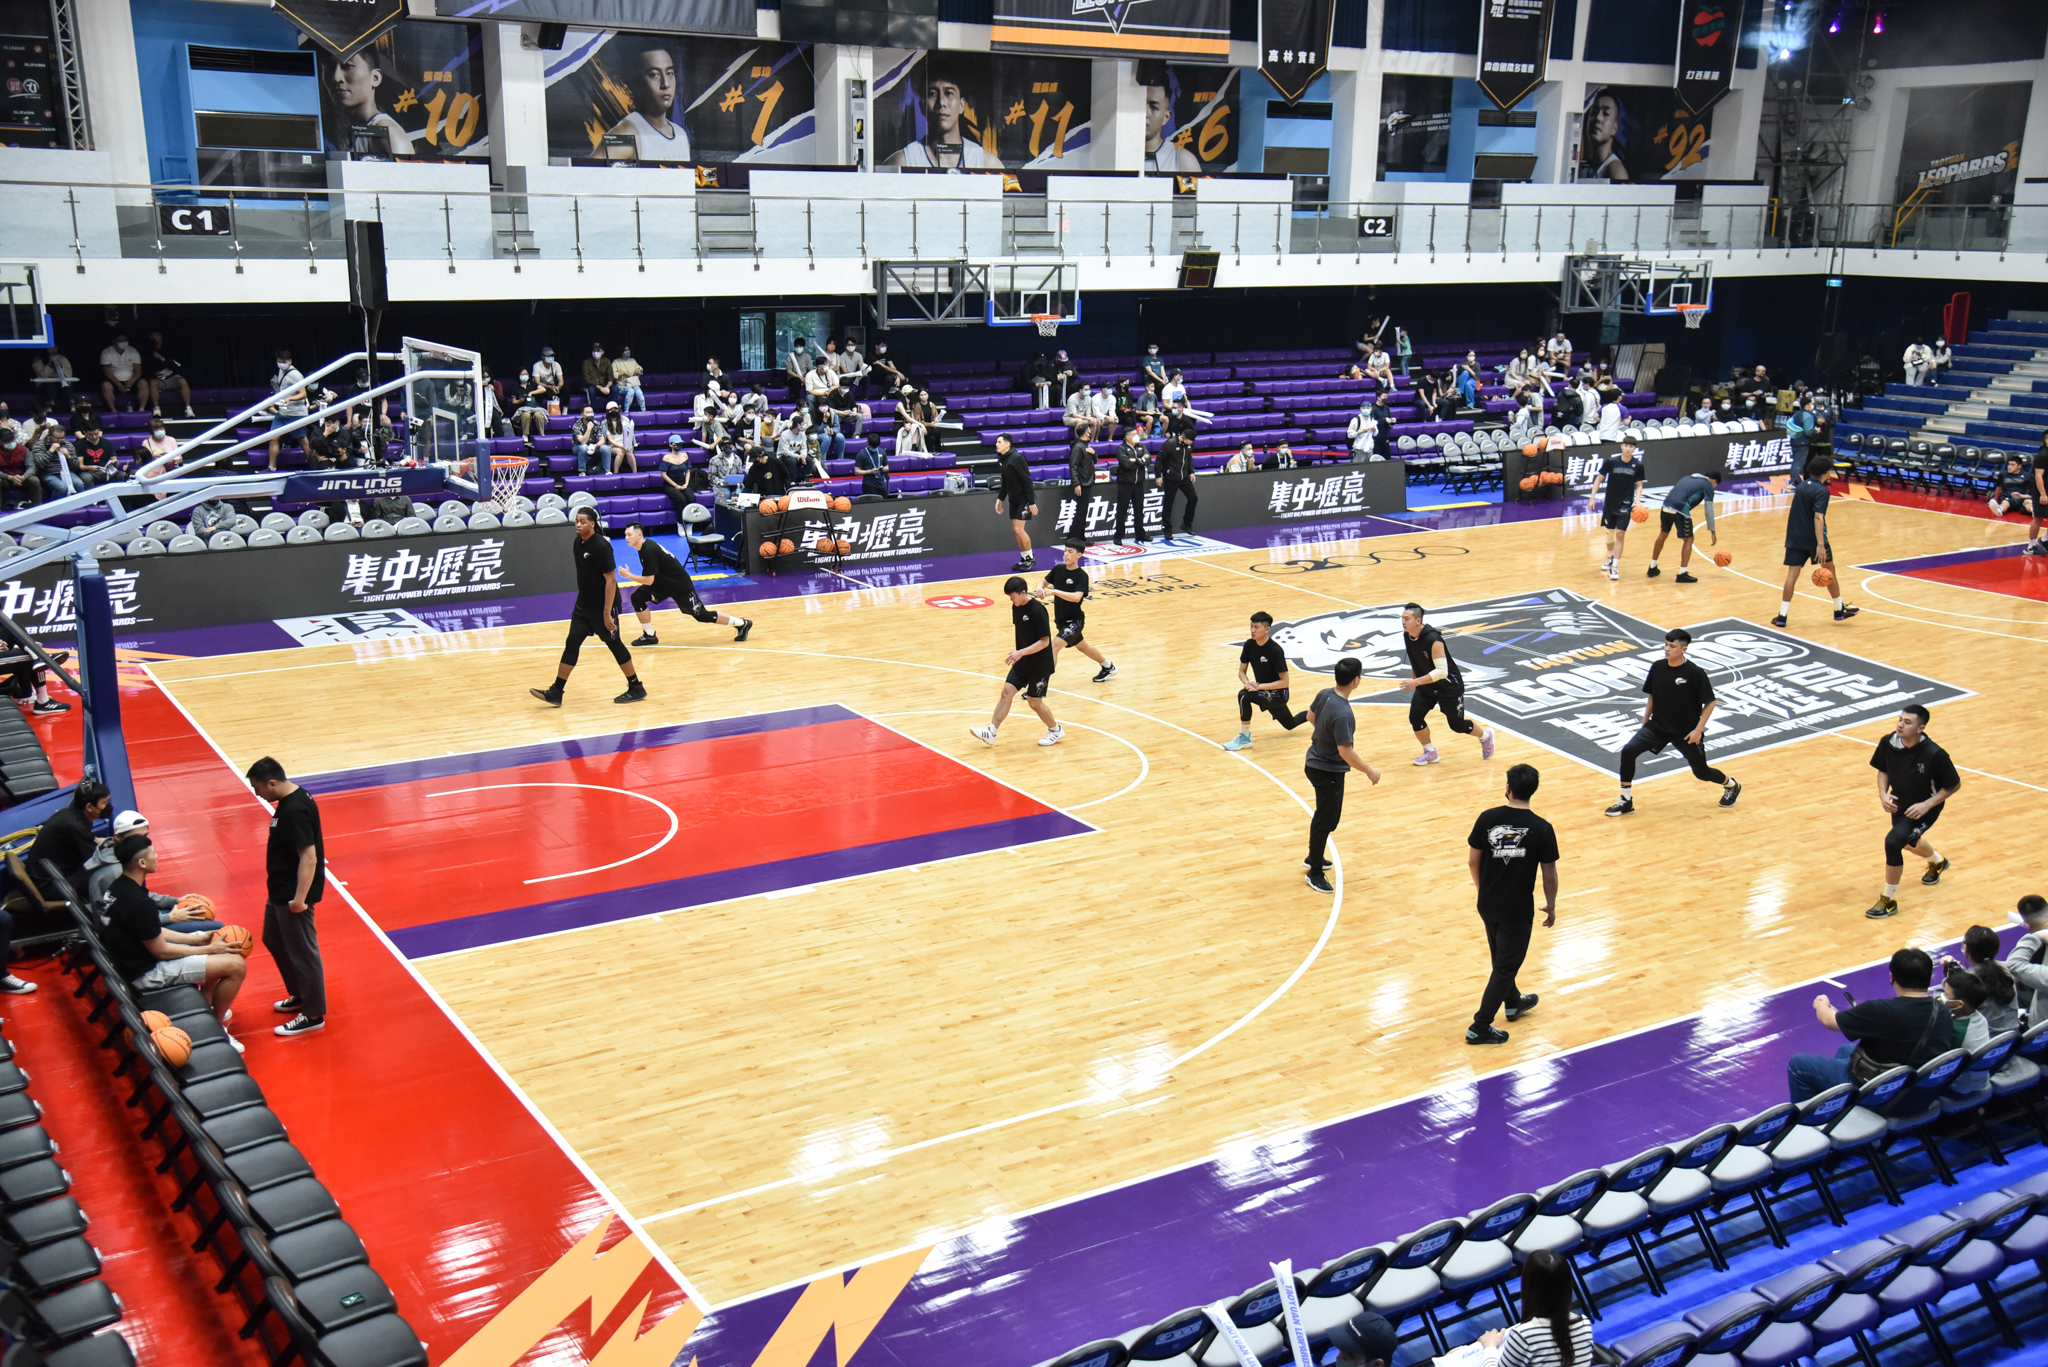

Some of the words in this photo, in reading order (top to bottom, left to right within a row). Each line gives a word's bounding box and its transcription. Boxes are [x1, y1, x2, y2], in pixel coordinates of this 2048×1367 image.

[393, 88, 480, 147] #10
[719, 80, 785, 146] #1
[1004, 99, 1075, 159] #11
[1173, 105, 1231, 162] #6
[1654, 124, 1706, 171] #92
[1917, 151, 2008, 189] LEOPARDS
[171, 209, 213, 231] C1
[1364, 218, 1386, 234] C2
[317, 477, 402, 491] JINLING
[366, 487, 402, 495] SPORTS
[1268, 470, 1366, 513] 集中壢亮
[341, 538, 506, 596] 集中壢亮
[1514, 640, 1639, 671] TAOYUAN
[1541, 661, 1899, 753] 集壢亮
[1285, 1285, 1302, 1326] TAOYUAN
